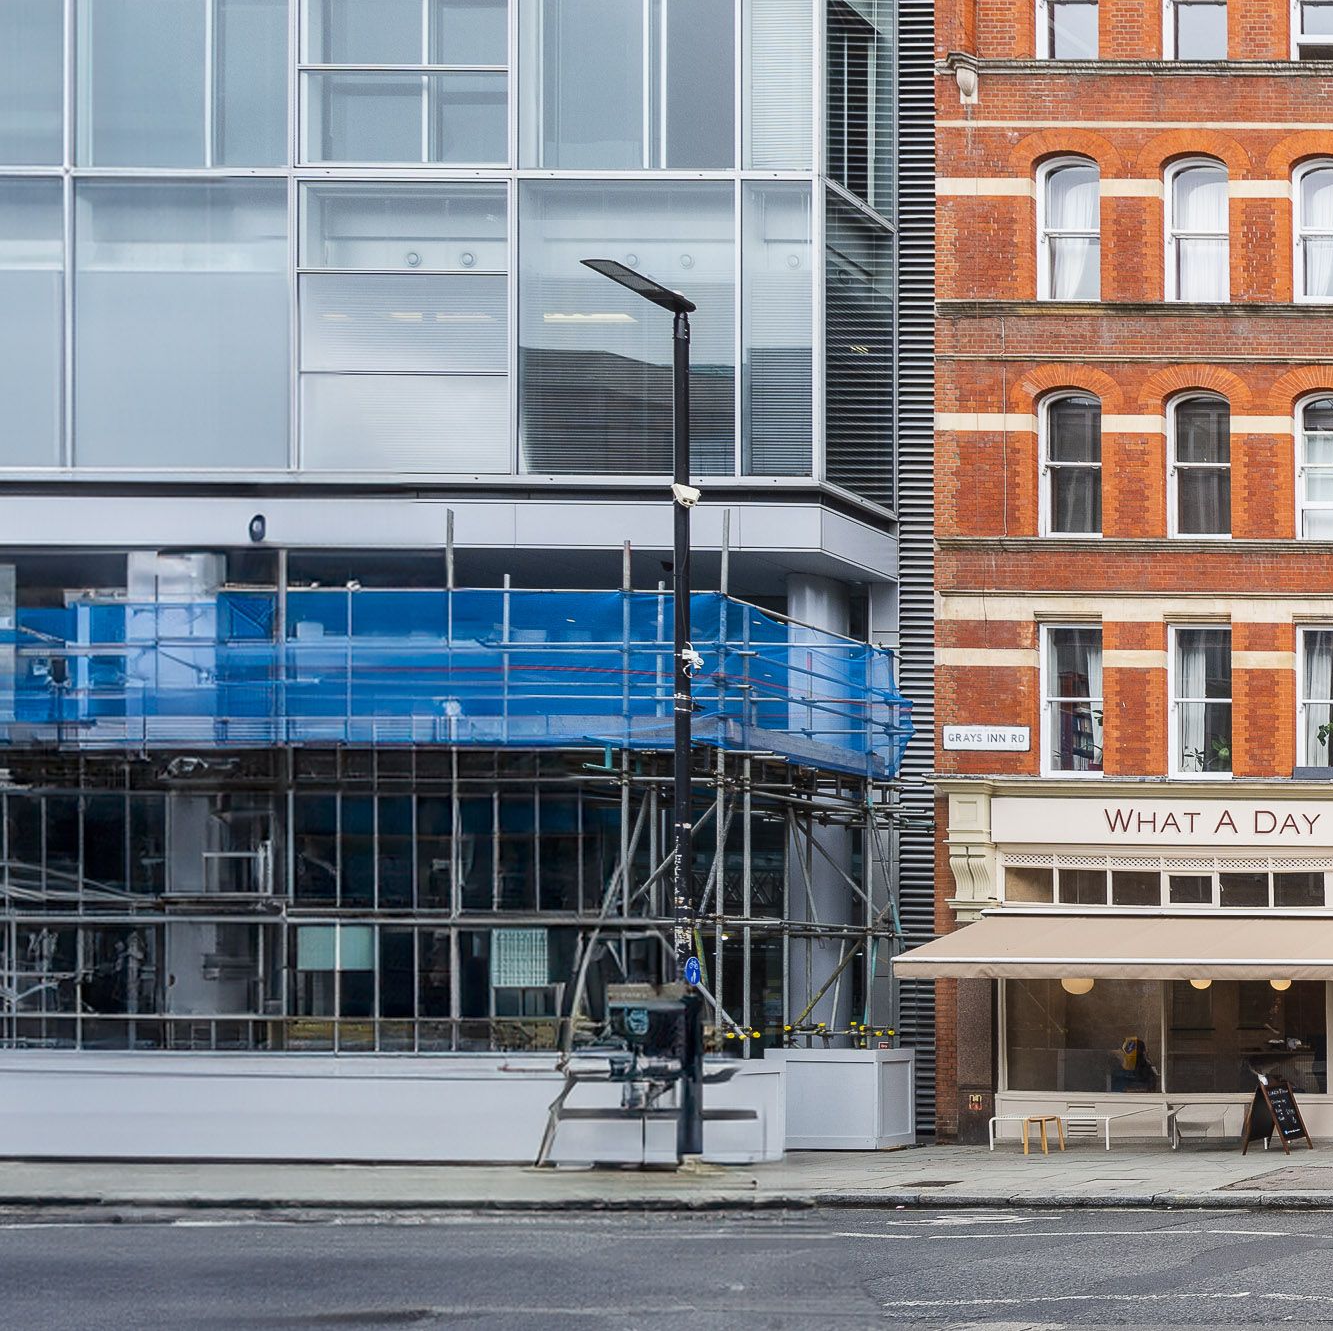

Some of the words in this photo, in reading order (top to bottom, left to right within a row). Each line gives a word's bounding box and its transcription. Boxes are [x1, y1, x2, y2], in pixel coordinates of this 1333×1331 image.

[948, 733, 983, 742] GRAYS
[987, 734, 1006, 743] INN
[1011, 734, 1025, 743] RD
[1104, 808, 1201, 833] WHAT
[1214, 810, 1239, 834] A
[1254, 810, 1321, 835] DAY
